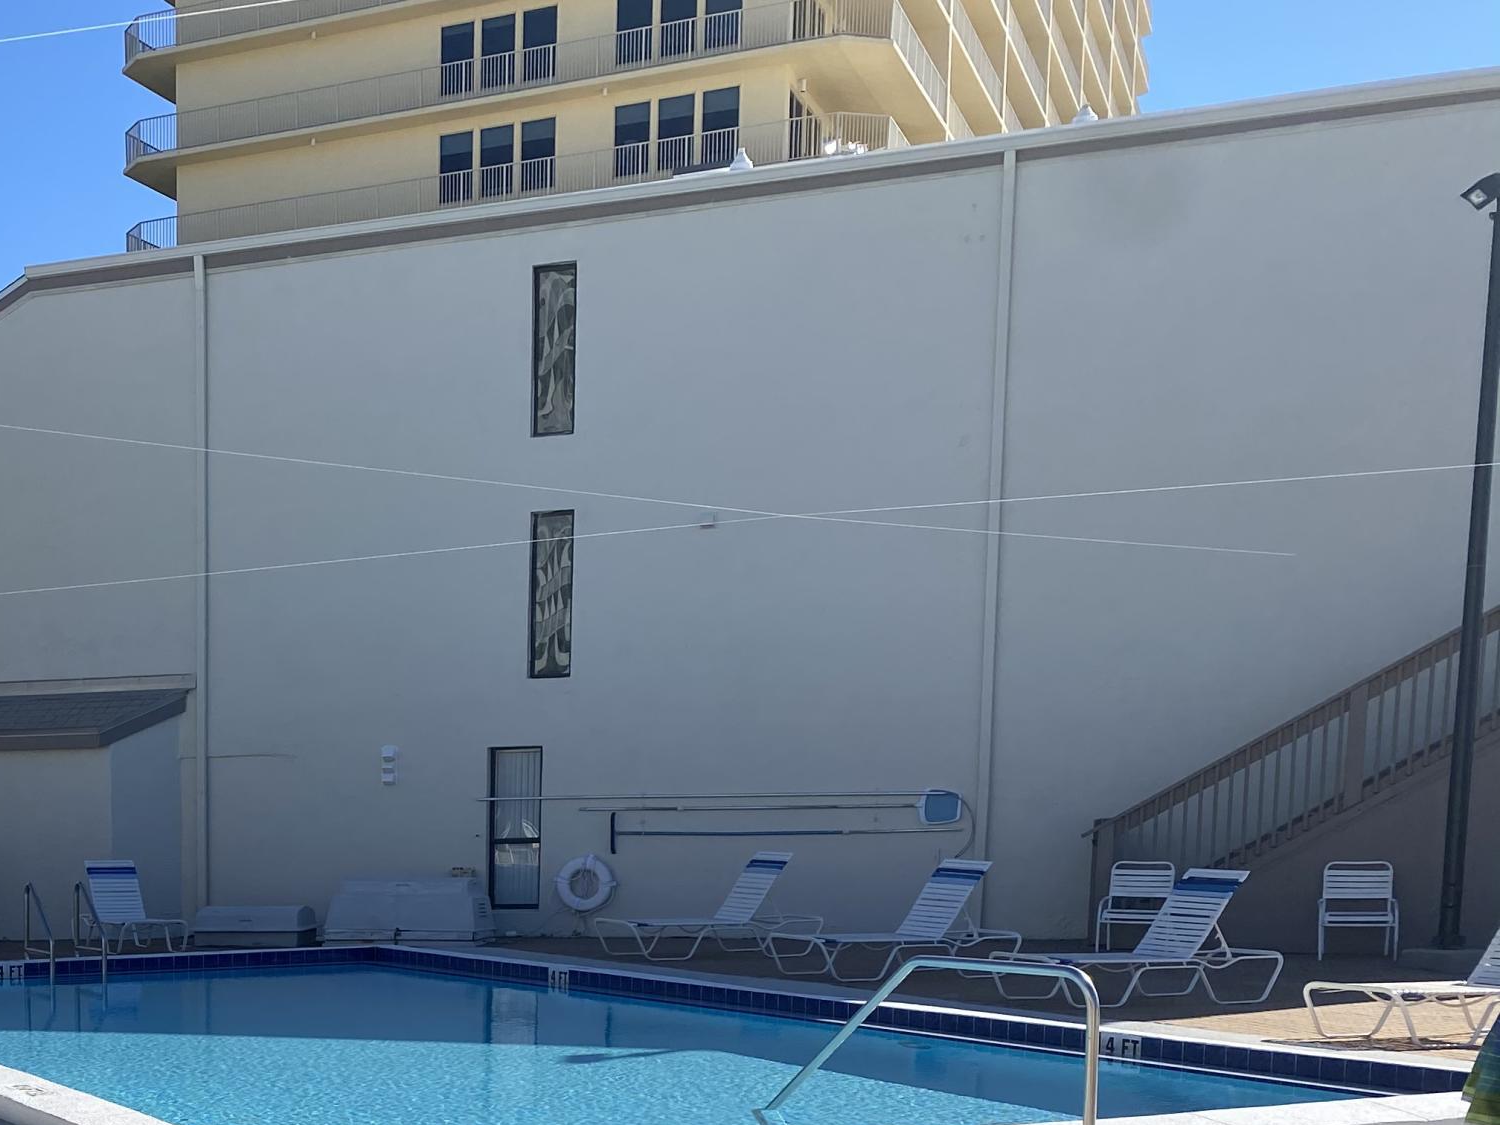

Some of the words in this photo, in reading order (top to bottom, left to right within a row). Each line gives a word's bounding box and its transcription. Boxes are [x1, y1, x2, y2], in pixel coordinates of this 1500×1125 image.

[10, 965, 23, 978] FT
[559, 972, 567, 984] FT
[1106, 1036, 1115, 1056] 4
[1121, 1038, 1139, 1058] FT
